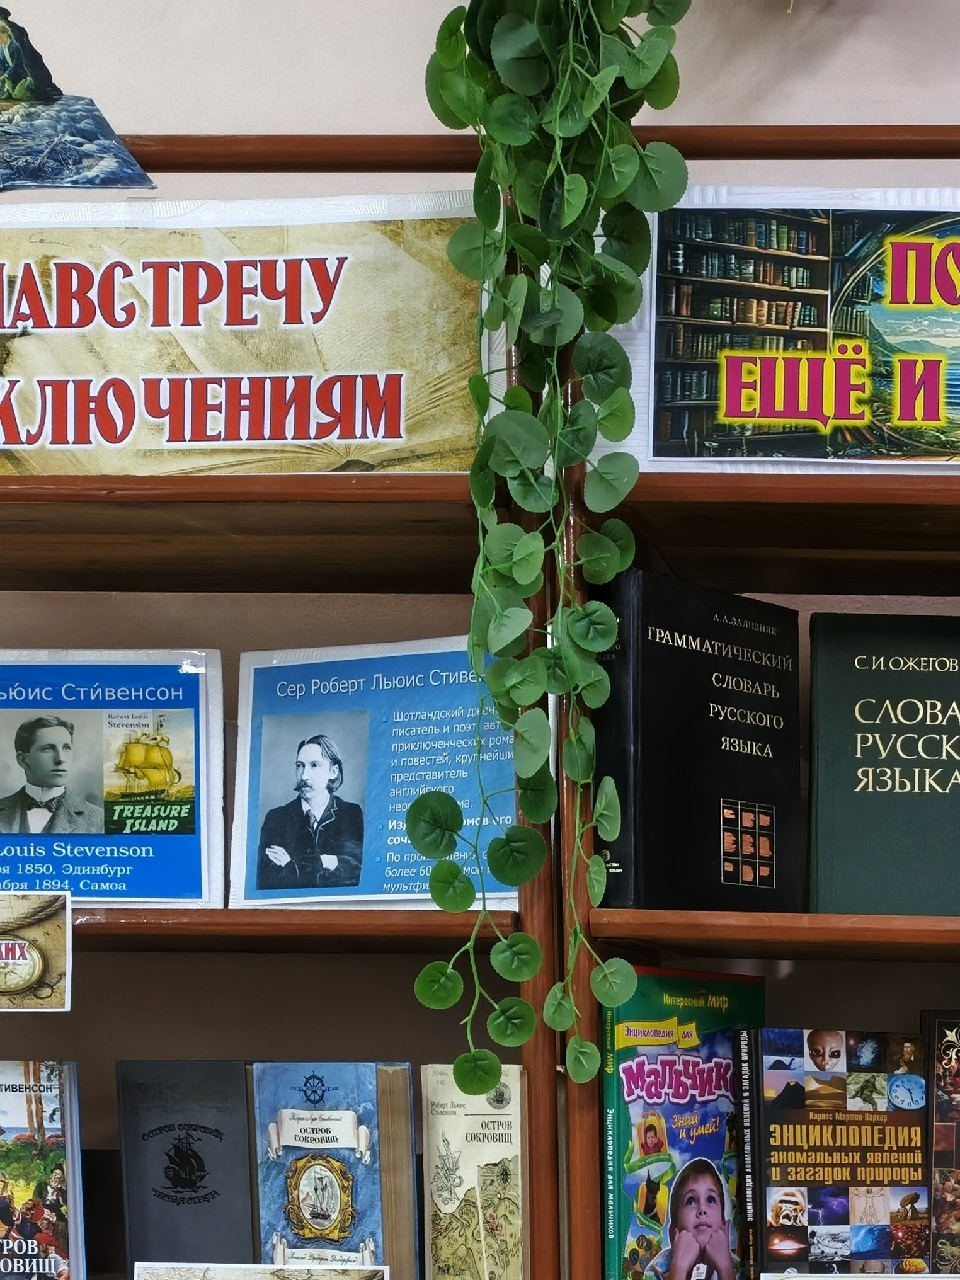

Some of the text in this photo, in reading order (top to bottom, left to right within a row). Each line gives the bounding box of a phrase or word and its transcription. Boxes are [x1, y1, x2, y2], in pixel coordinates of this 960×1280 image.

[0, 257, 347, 329] АВСТРЕЧУ
[723, 344, 867, 431] ЕЩЁ
[897, 359, 945, 423] И
[647, 626, 793, 673] ГРАММАТИЧЕСКИЙ
[277, 673, 424, 700] Сер Роберт Льюис
[712, 672, 780, 699] СЛОВАРЬ
[393, 706, 464, 722] Шотландский
[709, 703, 784, 730] РУССКОГО
[392, 725, 440, 738] писатель
[720, 736, 773, 758] ЯЗЫКА
[390, 769, 468, 783] представитель
[113, 804, 190, 818] TREASURE
[123, 819, 178, 833] ISLAND
[53, 843, 154, 858] Stevenson
[62, 864, 133, 881] Эдинбург
[80, 880, 127, 891] Самоа
[624, 1025, 674, 1039] Энциклопедия
[299, 1126, 332, 1136] ОСТРОВ
[481, 1120, 513, 1132] ОСТРОВ
[294, 1135, 339, 1145] СОКРОВИЩ
[465, 1132, 513, 1146] СОКРОВИЩ
[769, 1124, 921, 1150] ЭНЦИКЛОПЕДИЯ
[770, 1149, 922, 1164] аномальных явлений
[787, 1167, 922, 1185] загадок природы
